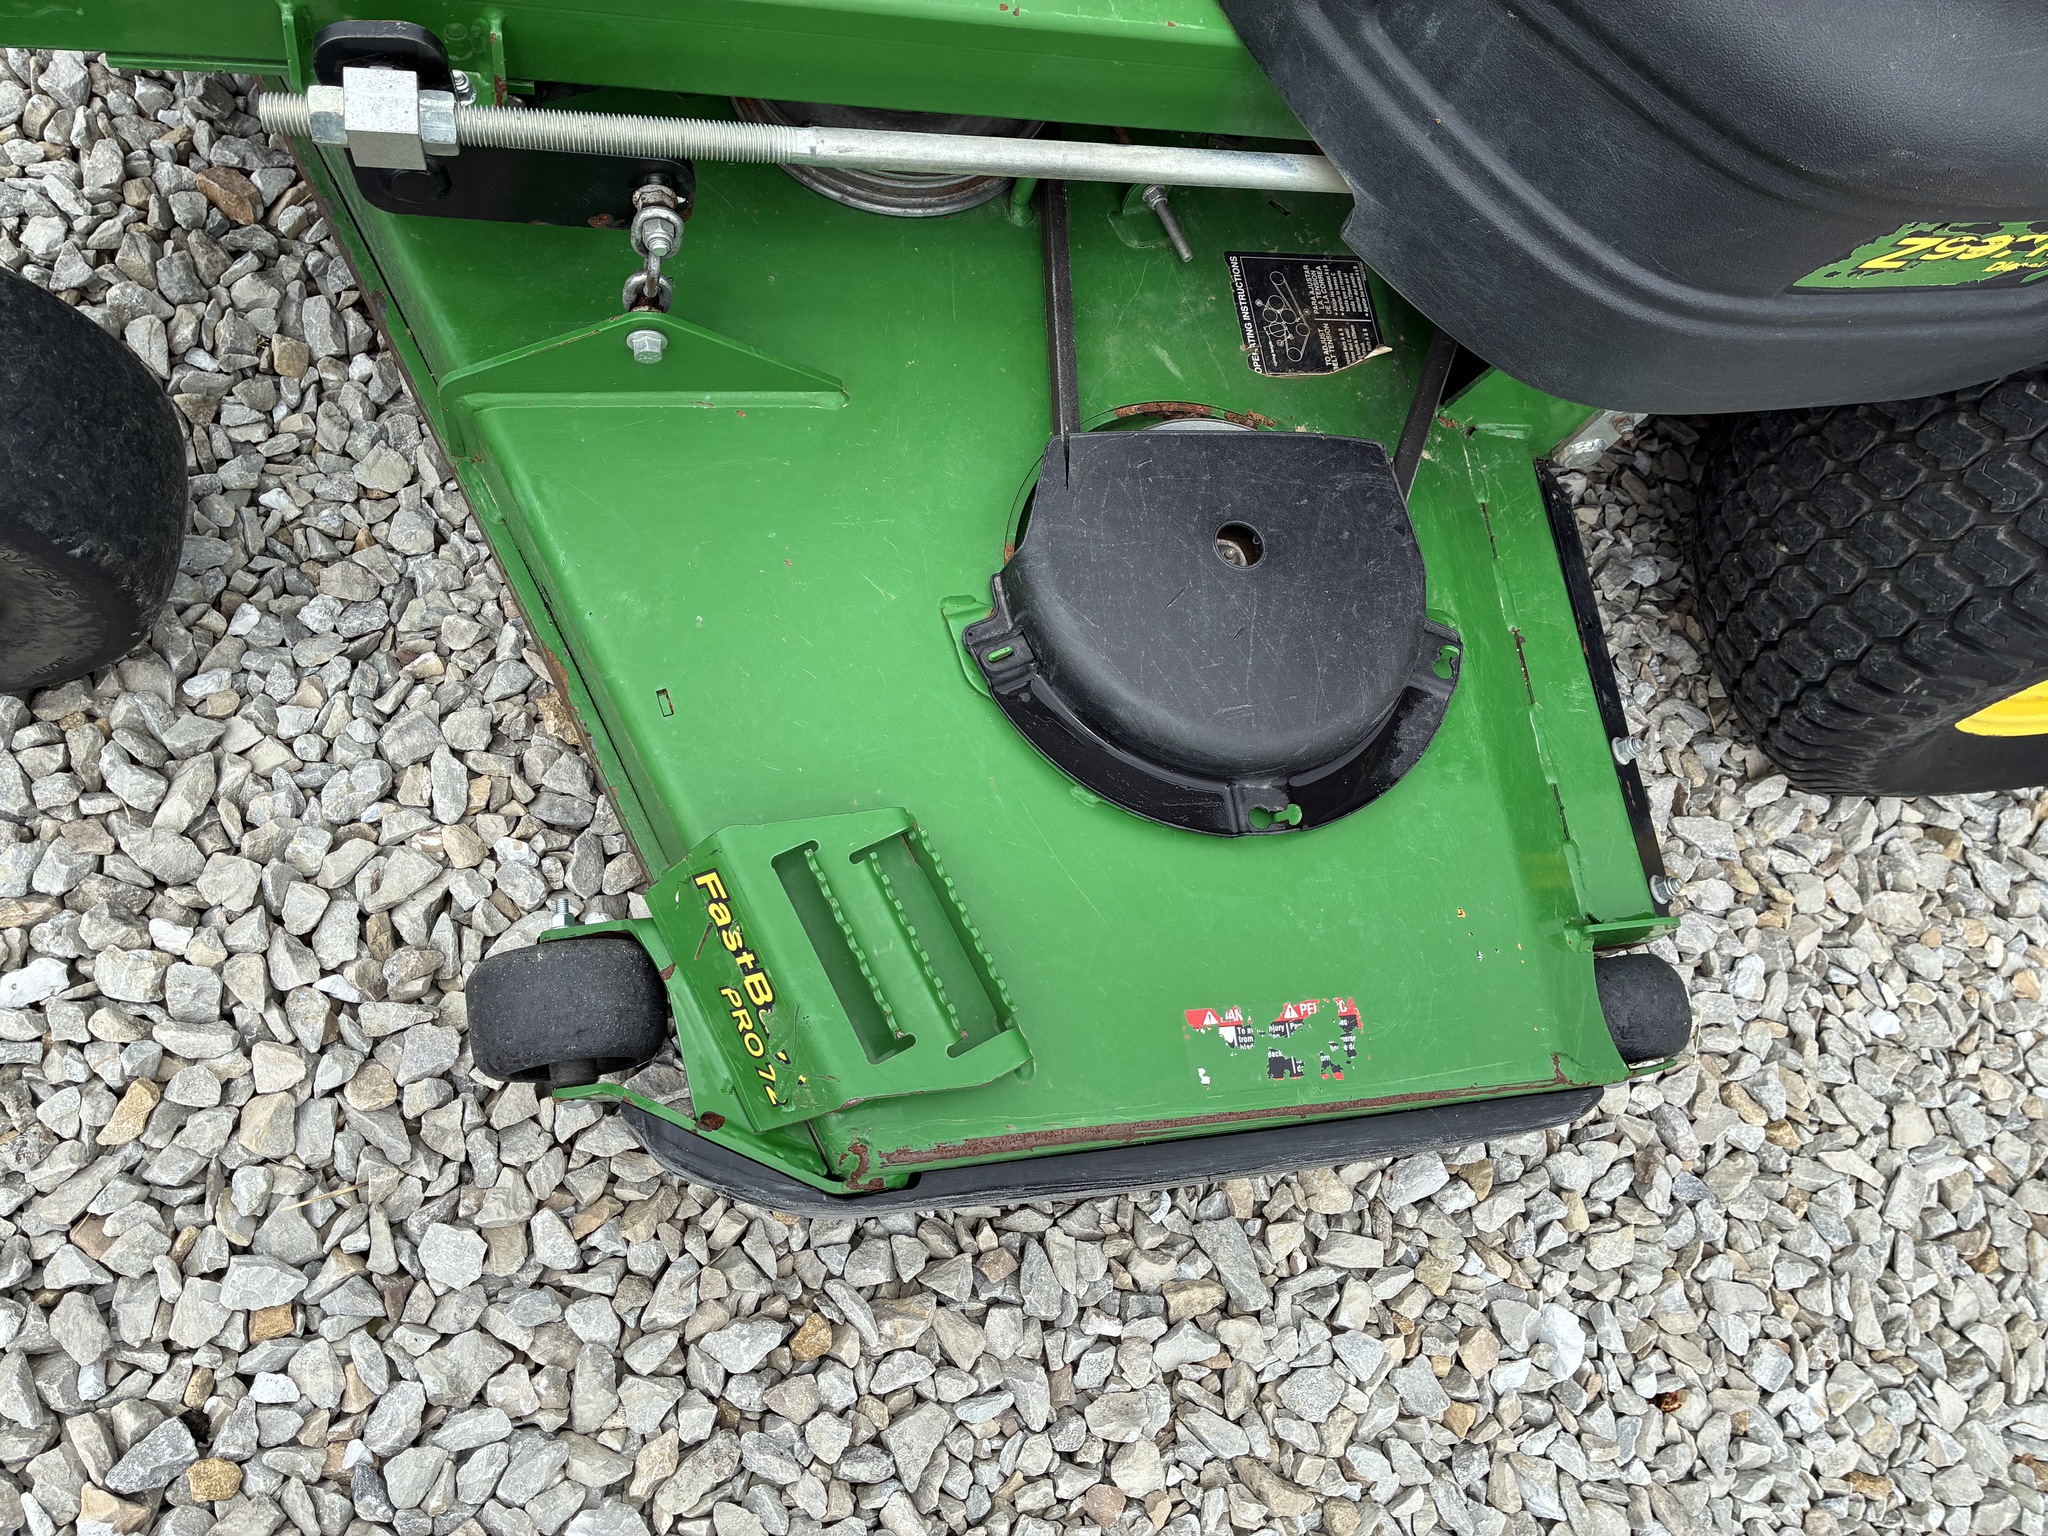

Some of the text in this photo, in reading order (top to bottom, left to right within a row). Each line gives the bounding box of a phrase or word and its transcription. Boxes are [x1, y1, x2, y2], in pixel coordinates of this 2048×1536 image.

[1228, 255, 1250, 320] INSTRUCTIONS
[1302, 264, 1319, 313] PARA AJUSTAR
[1309, 270, 1324, 309] LA TENSION
[1315, 265, 1332, 314] DE LA CORREA
[1317, 328, 1332, 365] TO ADJUST
[1322, 323, 1339, 369] BELT TENSION
[719, 986, 768, 1060] PRO
